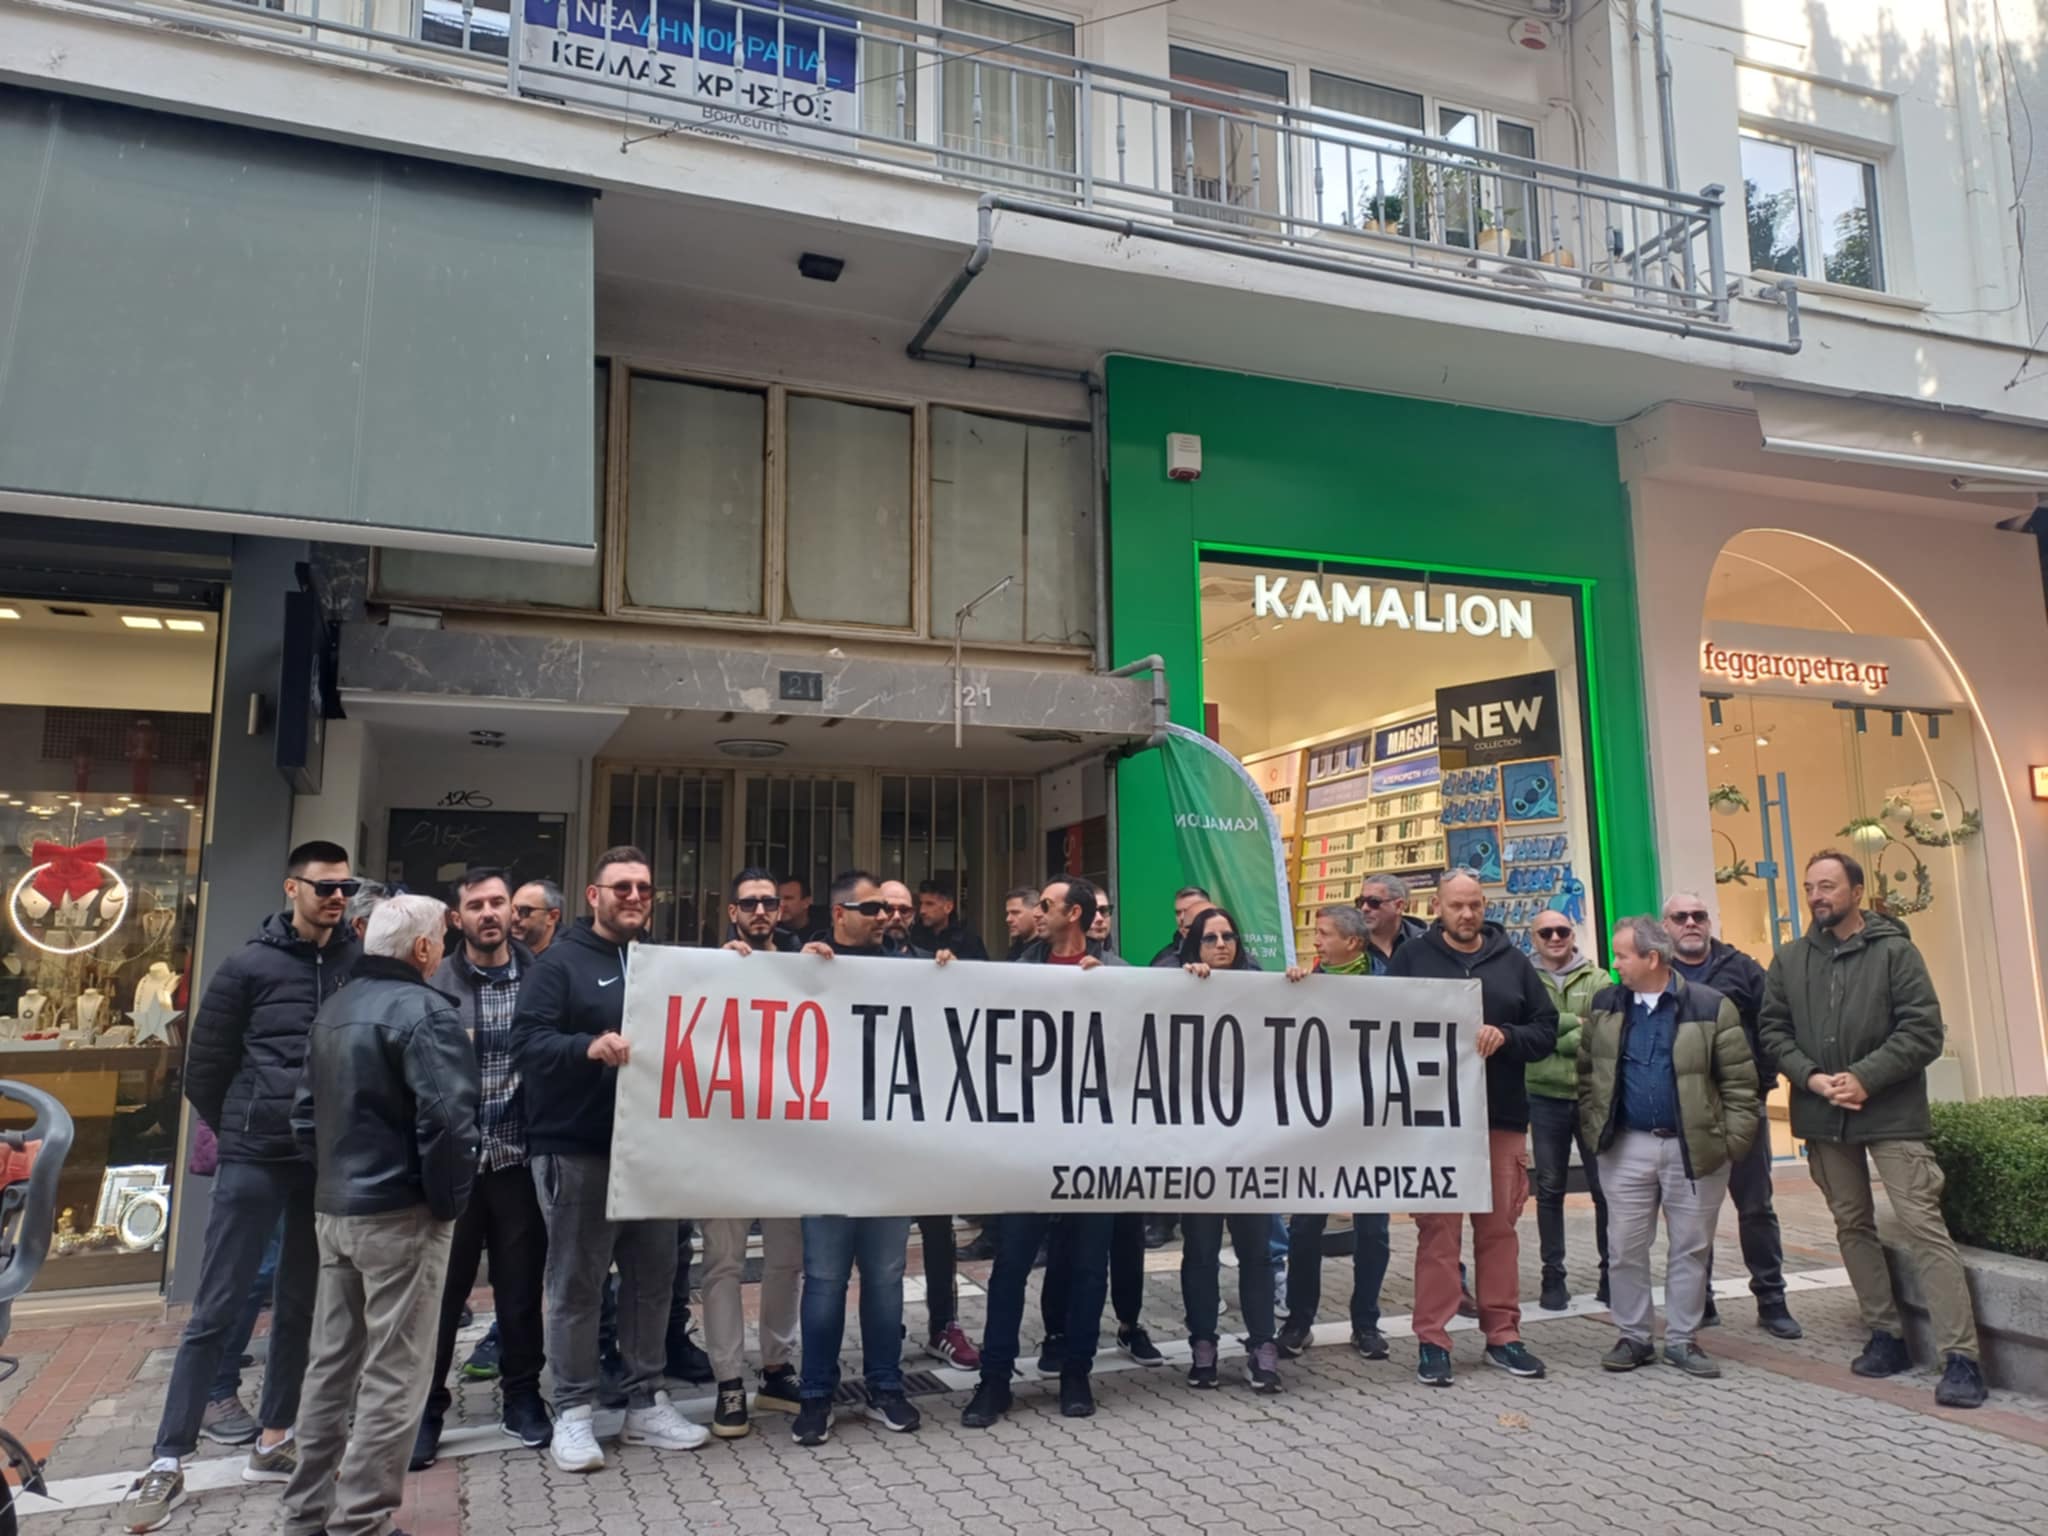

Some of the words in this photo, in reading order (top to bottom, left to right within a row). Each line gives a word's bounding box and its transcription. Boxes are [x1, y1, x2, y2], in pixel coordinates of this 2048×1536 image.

[1254, 574, 1533, 638] KAMALION
[1704, 643, 1889, 689] feggaropetra.gr
[788, 675, 816, 698] 21
[962, 686, 992, 707] 21
[1451, 696, 1543, 742] NEW
[1387, 721, 1439, 755] MAGSAF
[1474, 737, 1521, 751] COLLECTION
[658, 995, 829, 1120] ΚΑΤΩ
[851, 1004, 925, 1121] ΤΑ
[945, 1007, 1113, 1124] ΧΕΡΙΑ
[1132, 1013, 1245, 1127] ΑΠΟ
[1264, 1016, 1333, 1128] ΤΟ
[1350, 1020, 1461, 1128] ΤΑΞΙ
[1051, 1165, 1216, 1199] ΣΩΜΑΤΕΙΟ
[1226, 1166, 1288, 1199] ΤΑΞΙ
[1299, 1166, 1324, 1199] Ν.
[1333, 1166, 1458, 1199] ΛΑΡΙΣΑΣ
